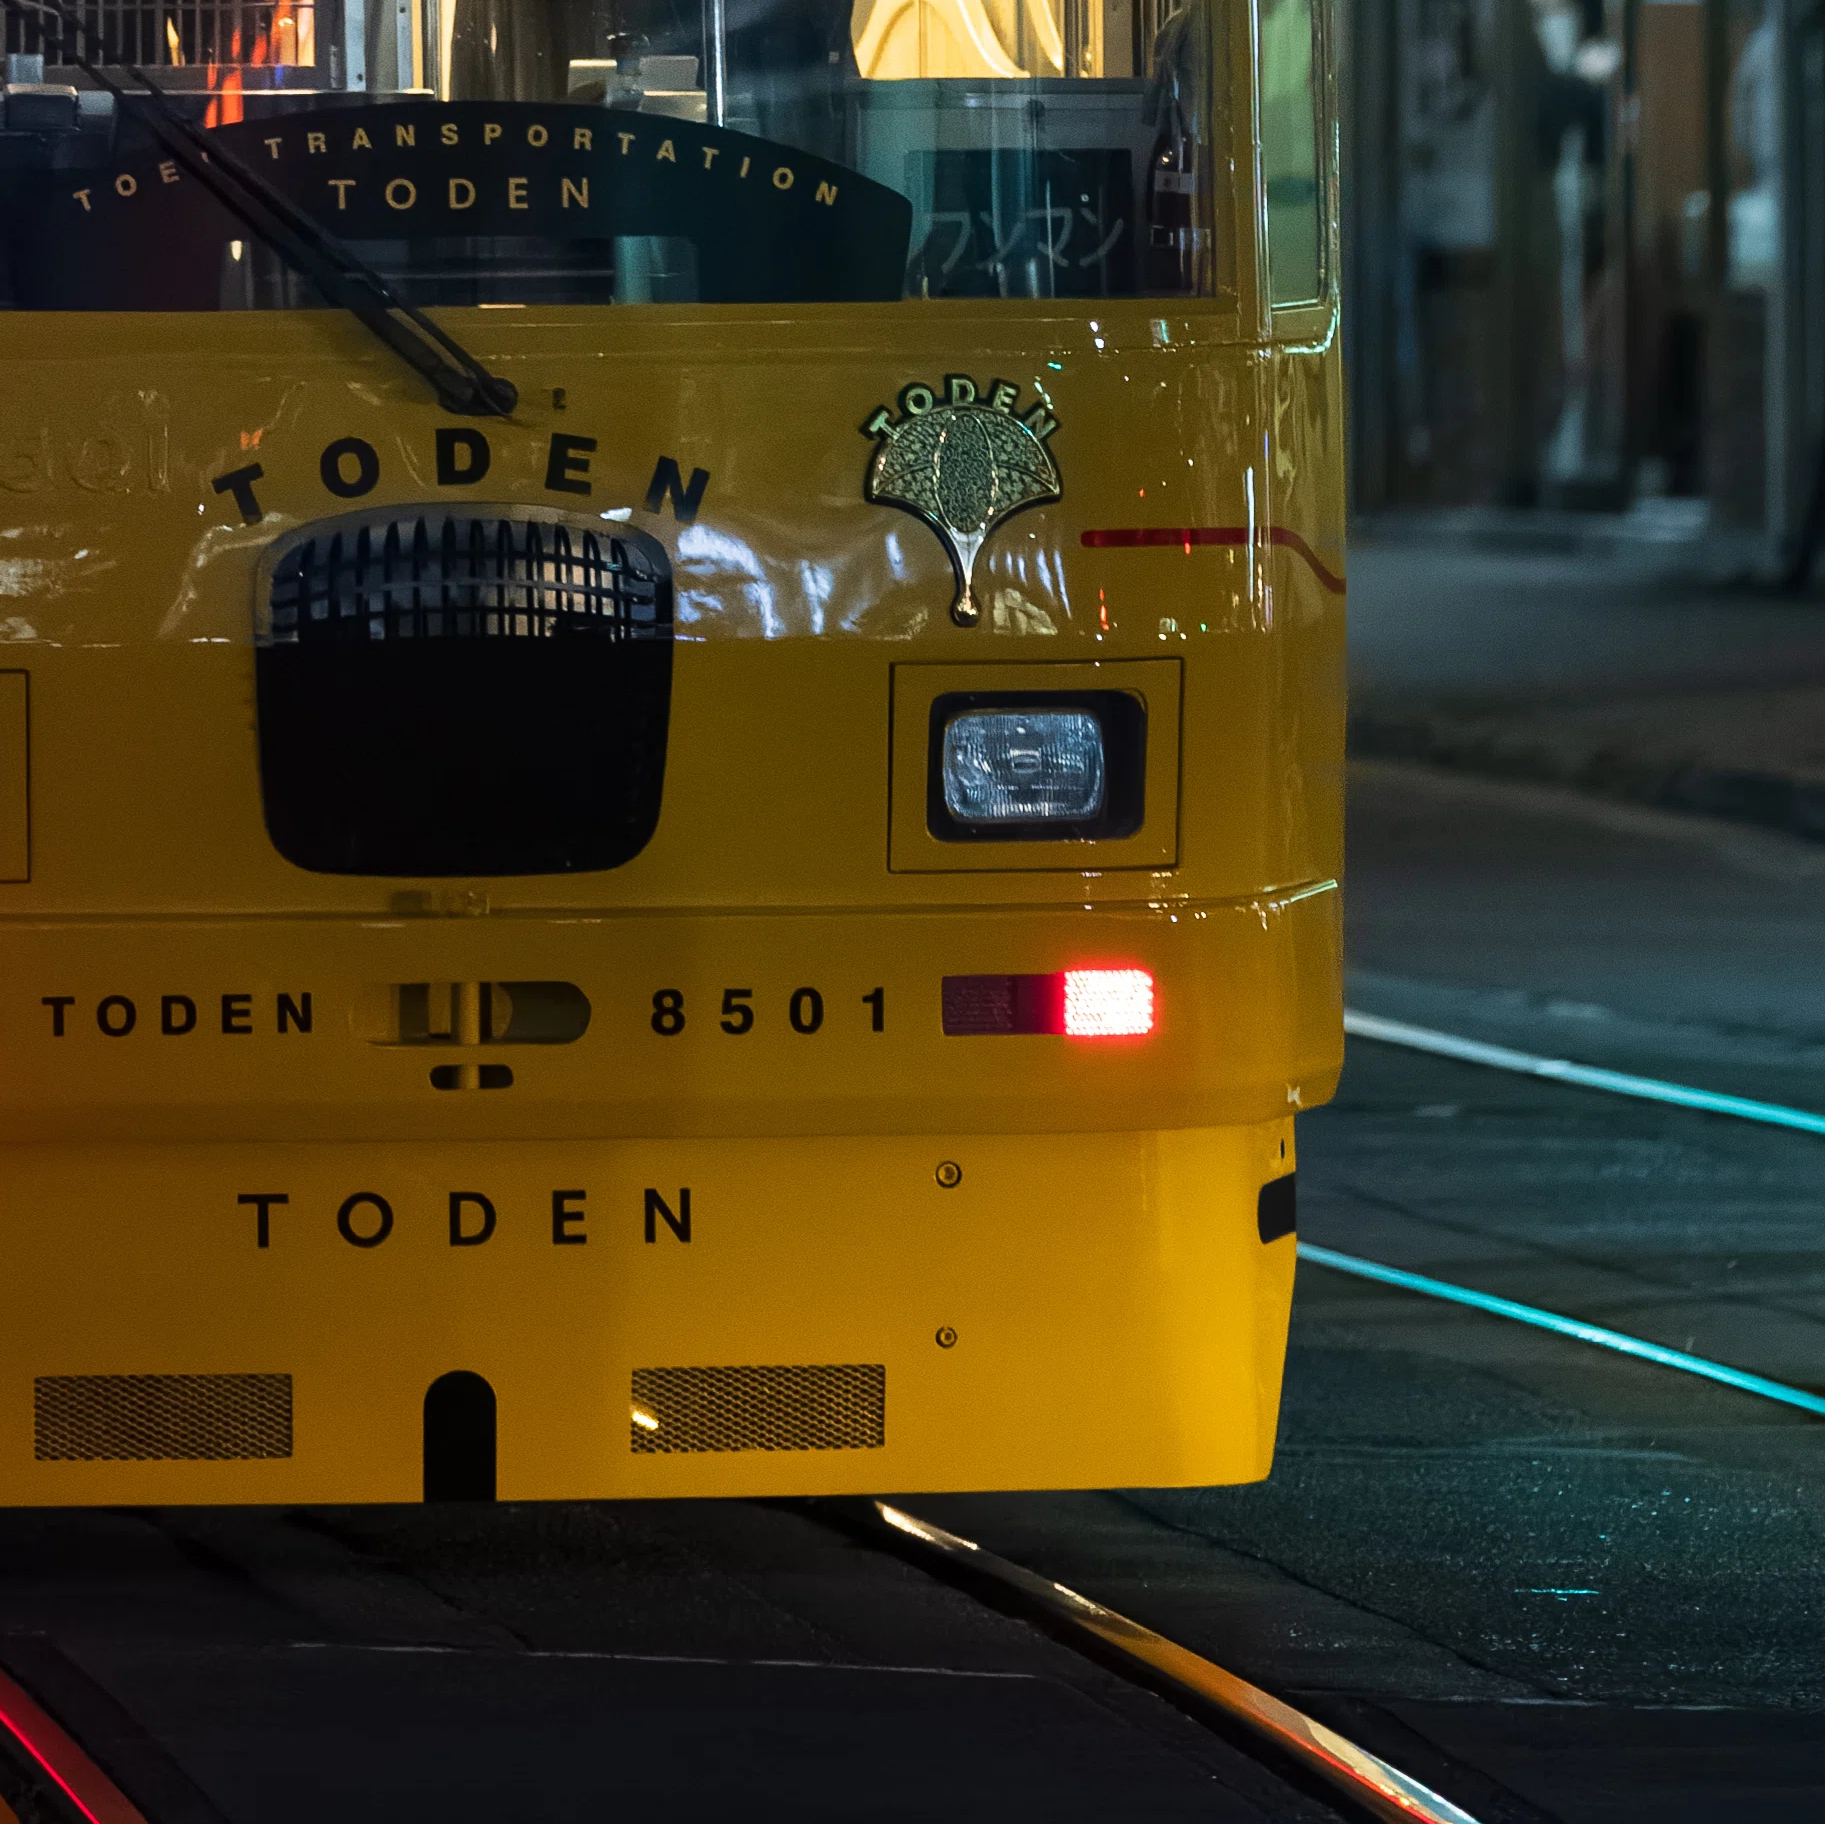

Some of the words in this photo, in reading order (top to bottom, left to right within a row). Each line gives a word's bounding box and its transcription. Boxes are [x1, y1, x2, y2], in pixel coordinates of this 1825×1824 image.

[264, 123, 840, 207] TRANSPORTATION
[328, 175, 591, 211] TODEN
[863, 374, 1059, 442] TODEN
[212, 427, 710, 526] TODEN
[40, 991, 315, 1038] TODEN
[649, 986, 885, 1037] 8501
[237, 1187, 693, 1250] TODEN
